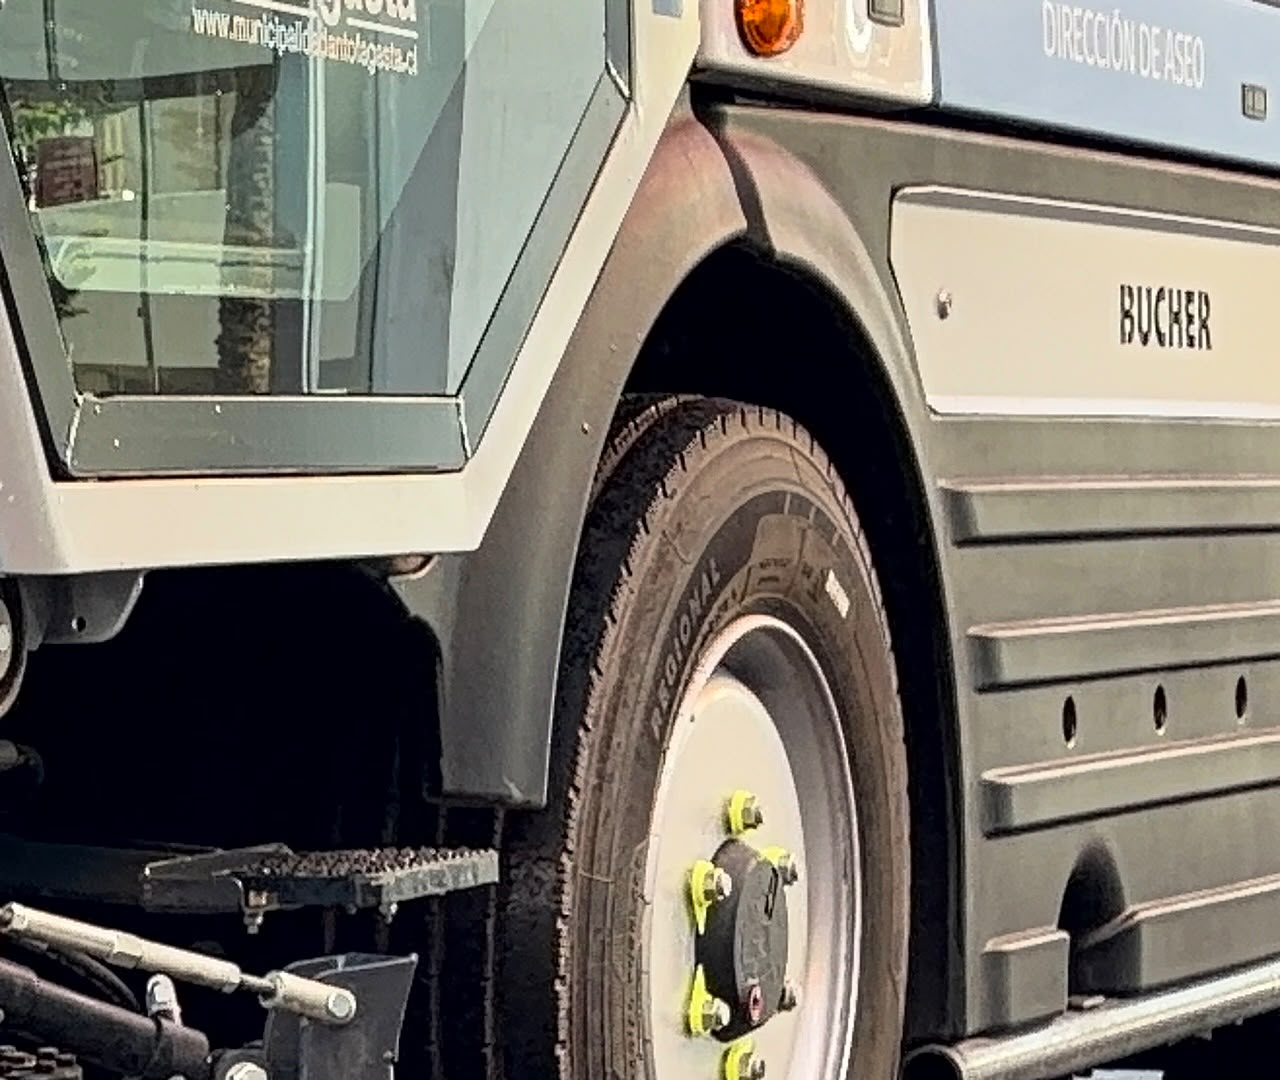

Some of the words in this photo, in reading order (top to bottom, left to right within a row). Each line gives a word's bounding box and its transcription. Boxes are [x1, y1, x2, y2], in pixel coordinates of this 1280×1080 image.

[1042, 1, 1135, 74] DIRECCIÓN
[1140, 22, 1162, 80] DE
[1164, 29, 1206, 89] ASEO
[1120, 284, 1212, 350] BUCHER
